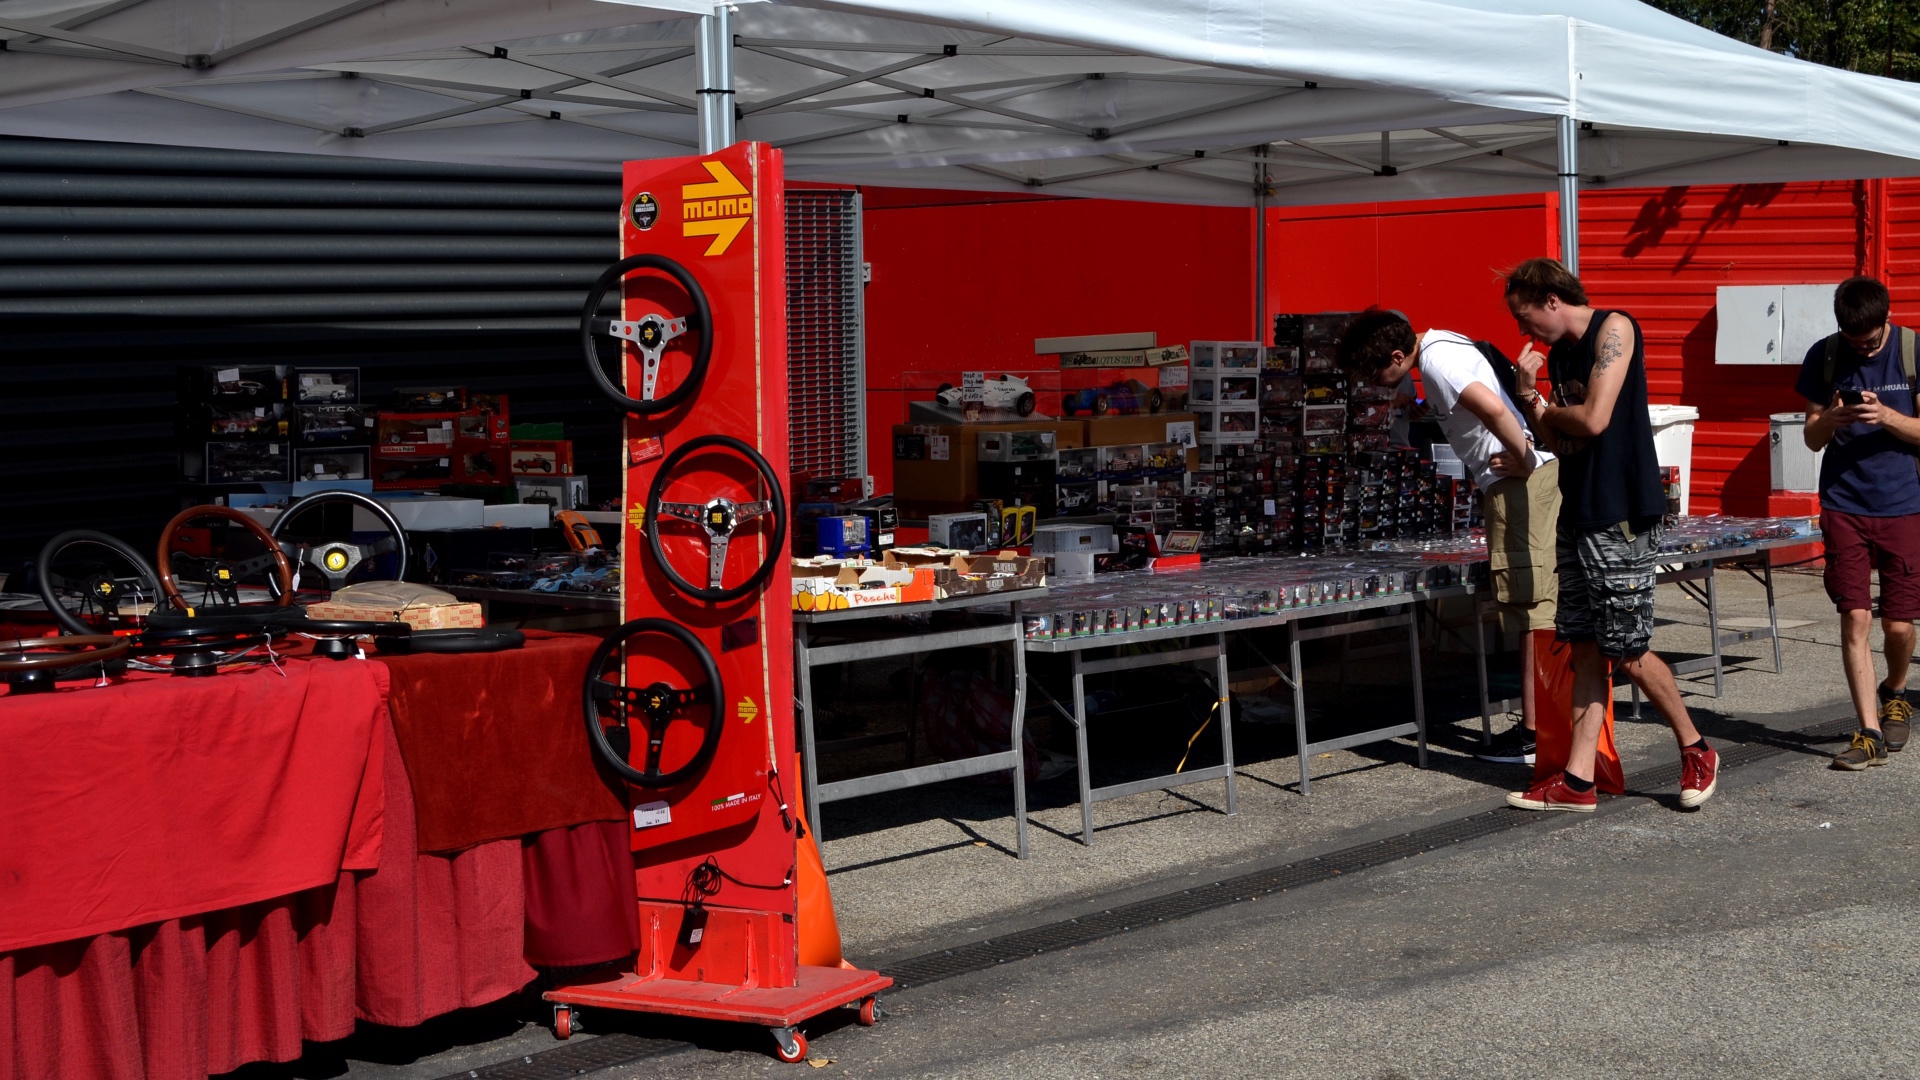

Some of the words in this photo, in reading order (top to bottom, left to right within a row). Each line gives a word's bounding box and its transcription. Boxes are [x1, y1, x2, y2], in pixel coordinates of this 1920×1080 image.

[683, 197, 753, 219] momo
[1096, 355, 1120, 365] LOTUS
[854, 593, 897, 605] Pesche
[725, 800, 740, 808] MADE
[748, 793, 761, 802] ITALY
